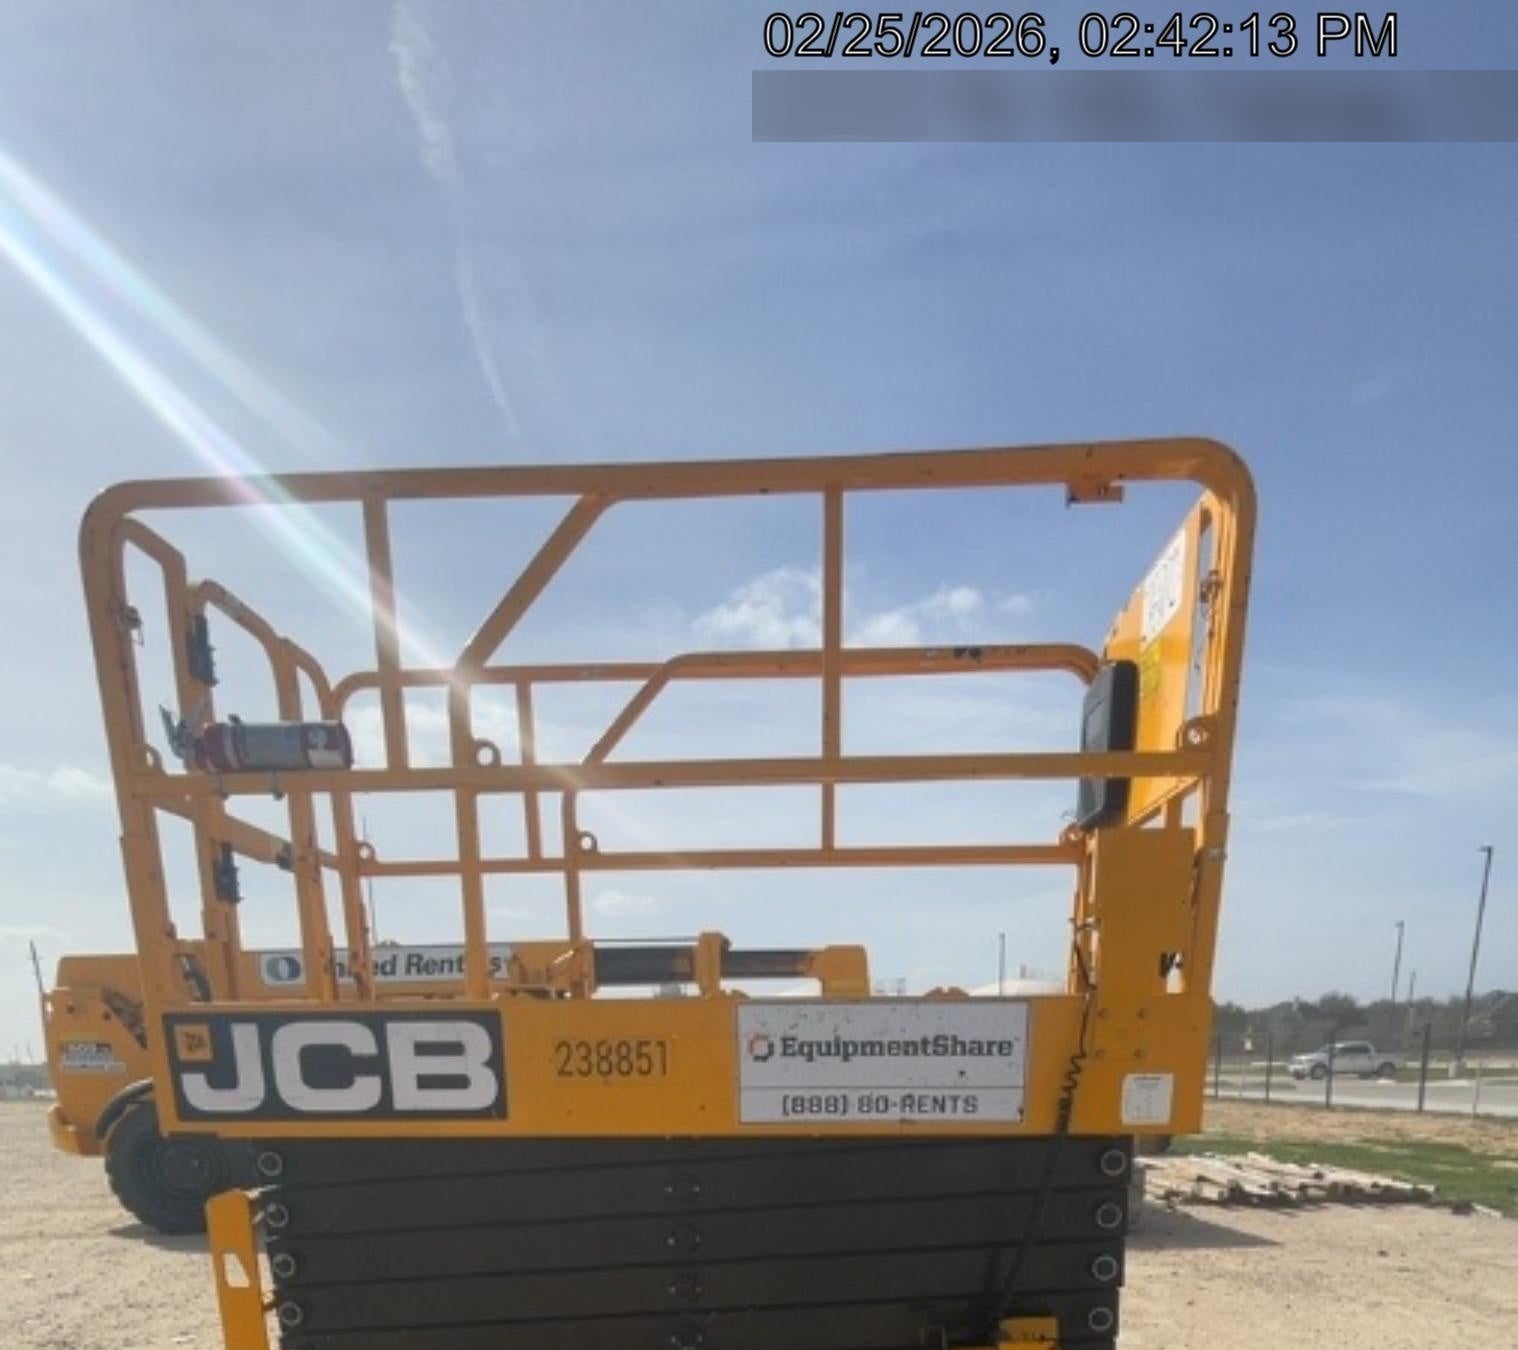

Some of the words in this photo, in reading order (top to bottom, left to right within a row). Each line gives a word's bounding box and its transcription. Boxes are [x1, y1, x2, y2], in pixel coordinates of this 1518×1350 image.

[555, 1039, 668, 1078] 238851
[780, 1035, 1014, 1062] EquipmentShare
[180, 1020, 499, 1112] JCB
[857, 1094, 979, 1115] 80-RENTS
